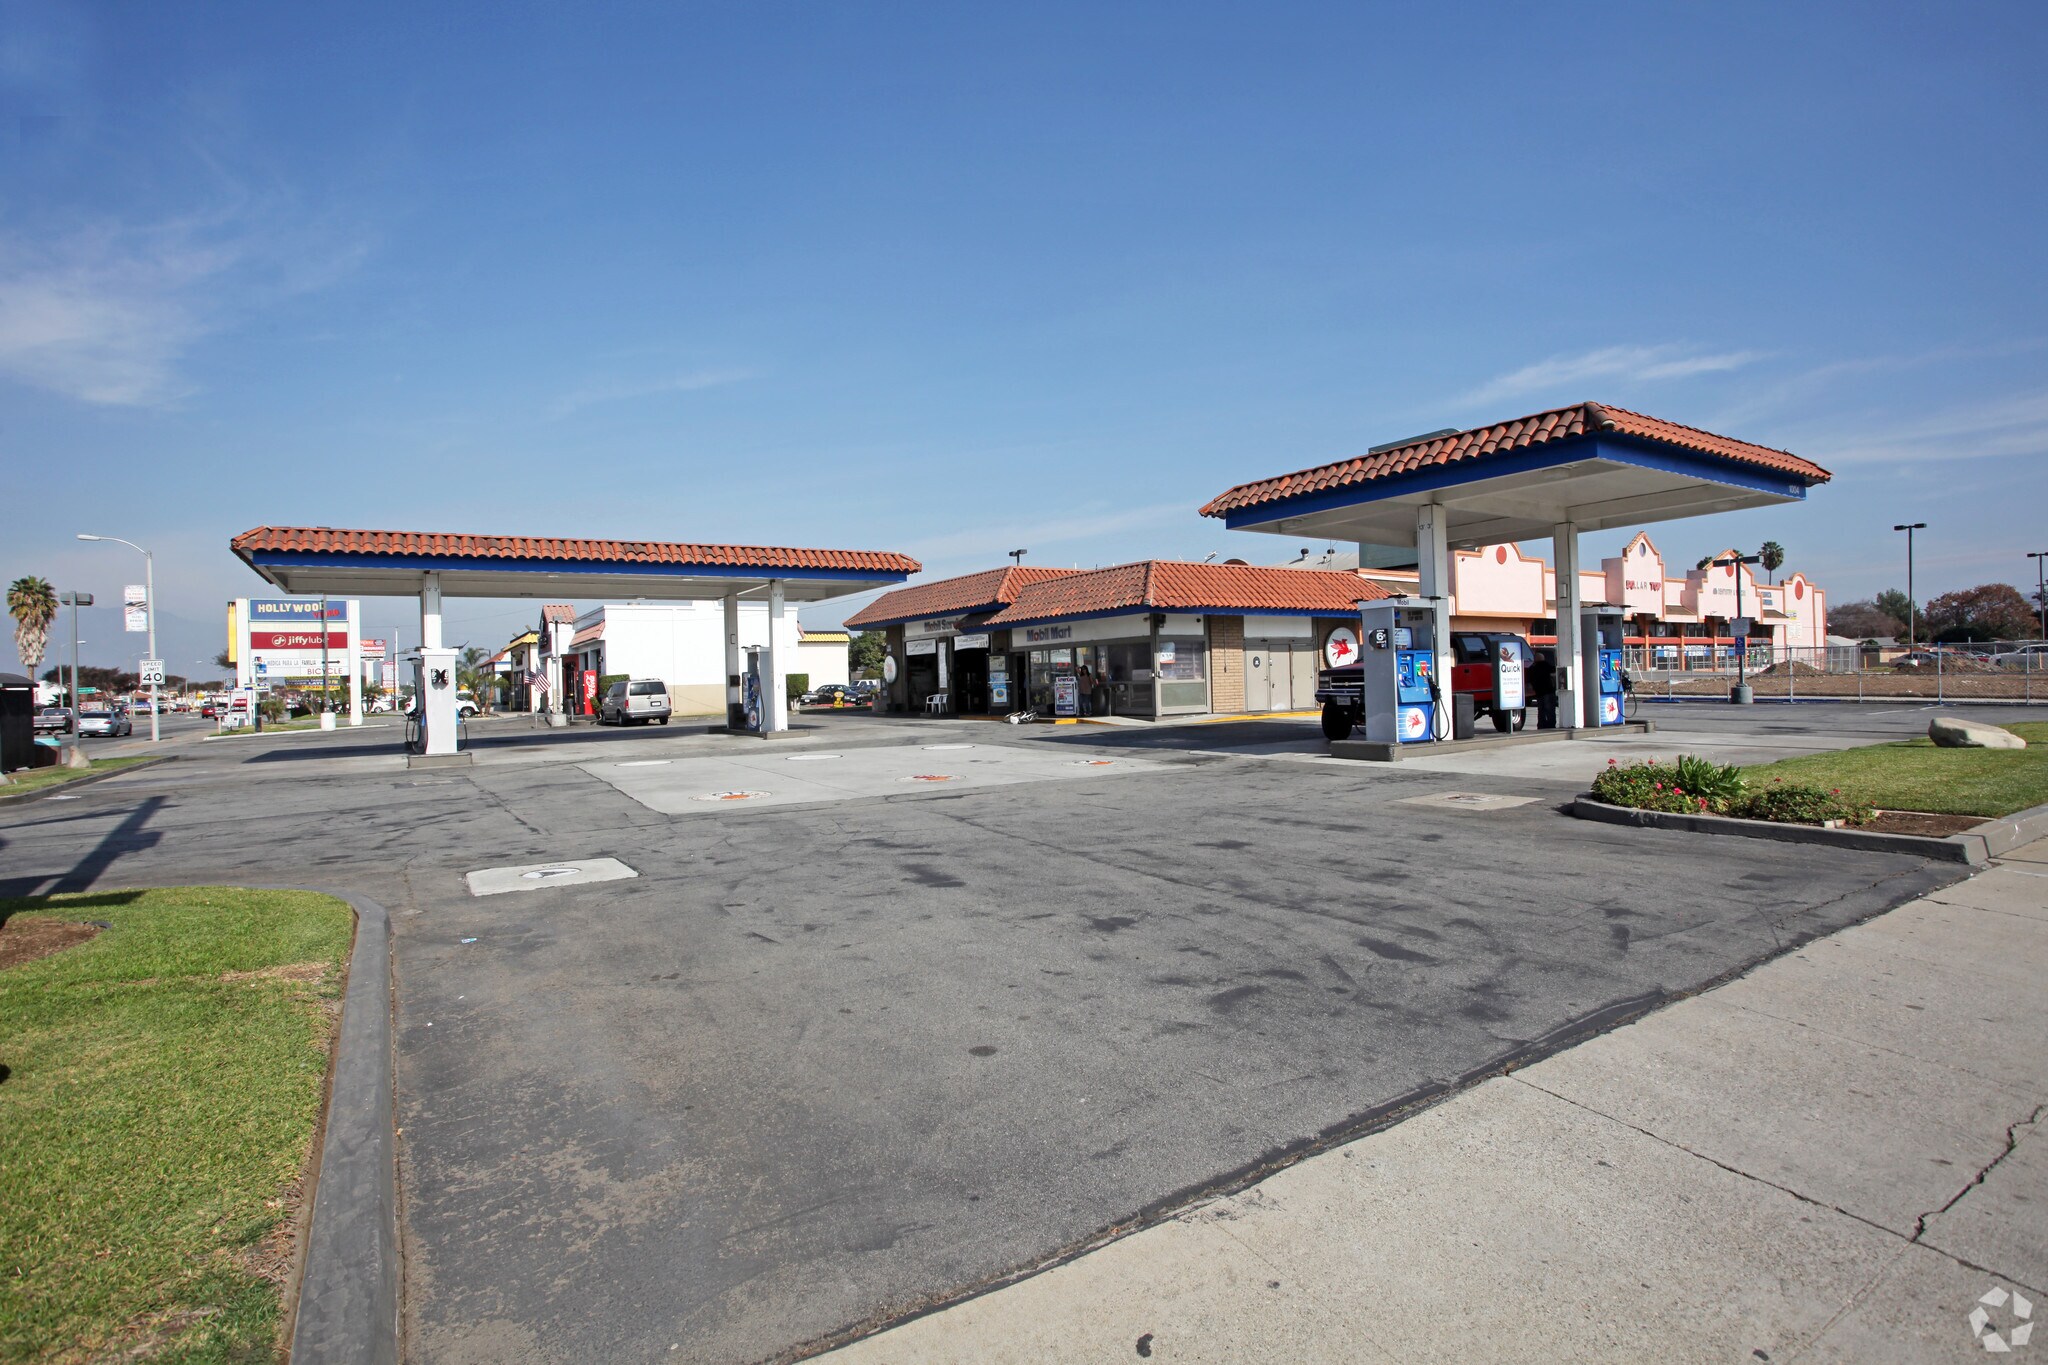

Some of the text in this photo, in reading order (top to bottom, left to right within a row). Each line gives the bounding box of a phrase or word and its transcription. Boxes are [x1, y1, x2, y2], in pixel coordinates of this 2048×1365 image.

[312, 608, 340, 619] VIEO
[924, 620, 941, 632] Mobil
[1026, 625, 1072, 642] Mobil Mart
[1500, 664, 1521, 673] Quick
[142, 672, 163, 682] 40
